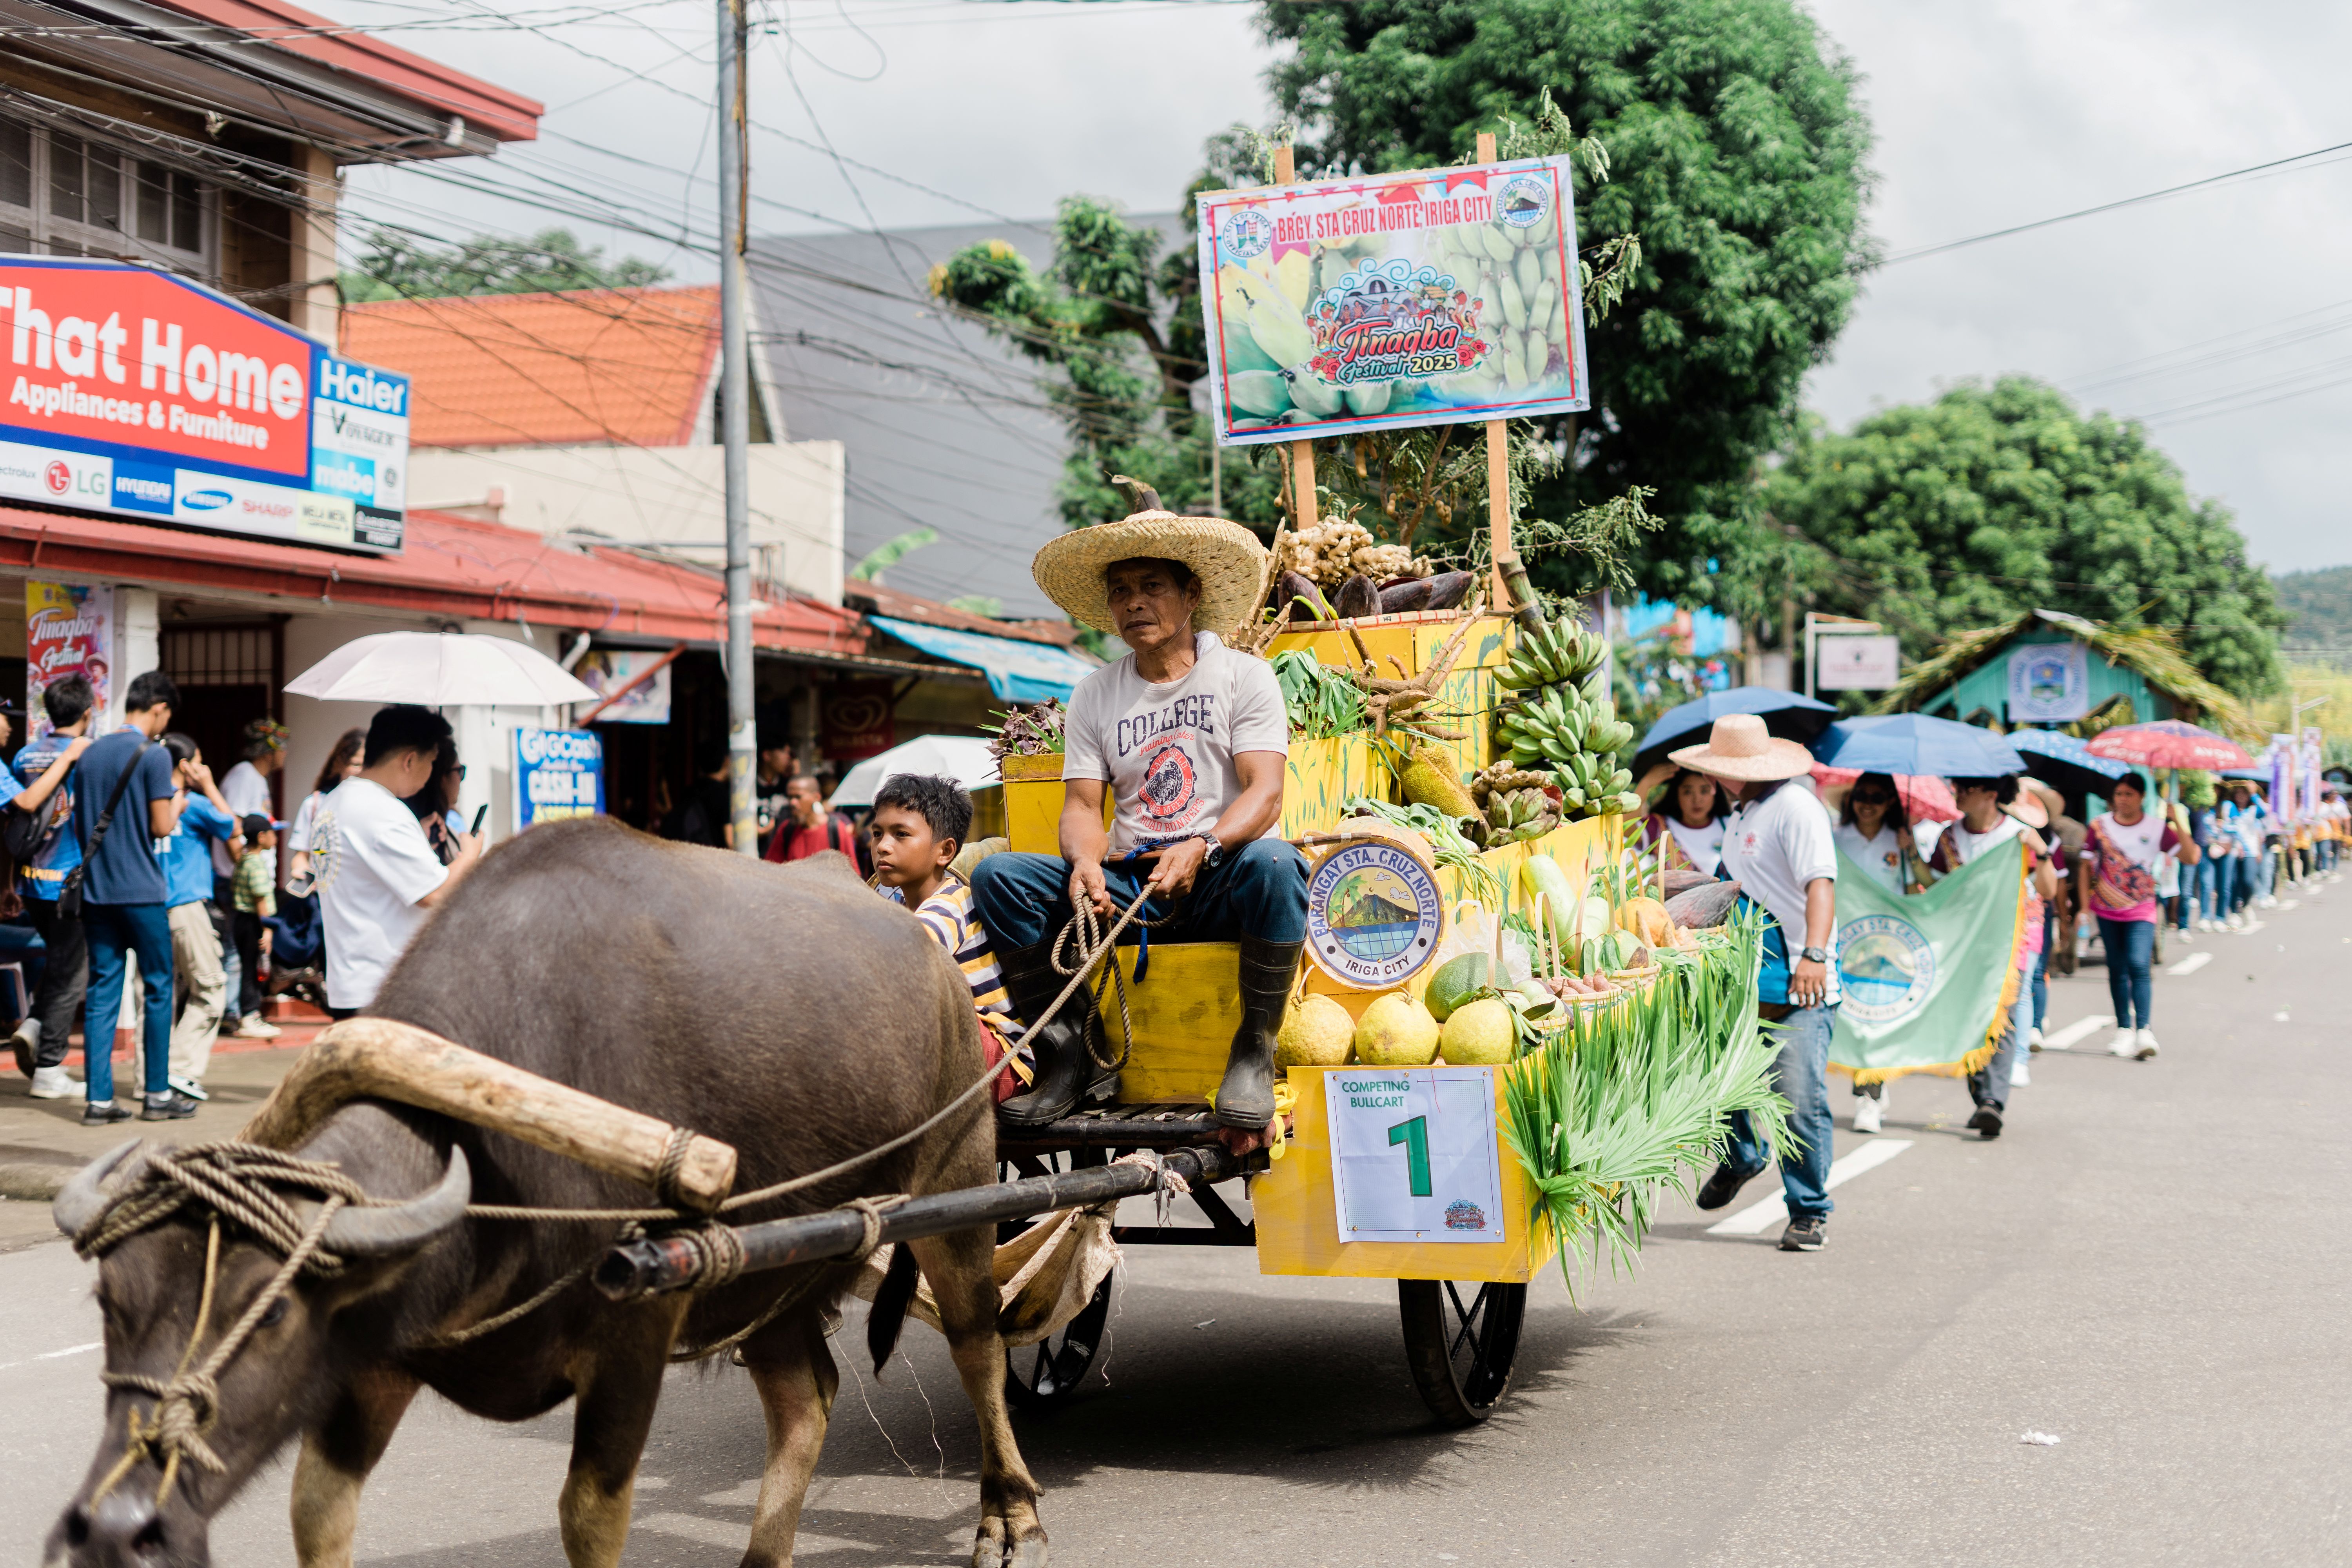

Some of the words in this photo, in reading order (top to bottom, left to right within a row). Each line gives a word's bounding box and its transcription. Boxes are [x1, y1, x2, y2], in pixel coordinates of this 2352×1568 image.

[1278, 215, 1313, 242] BRGY.
[1317, 212, 1339, 238] STA
[1343, 208, 1376, 235] CRUZ
[1425, 199, 1461, 227] IRIGA
[1464, 196, 1491, 222] CITY
[1227, 240, 1255, 256] OFFICIAL
[1257, 238, 1269, 251] SEAL
[1337, 318, 1458, 363] Tinagba
[140, 318, 304, 420] Home
[1339, 357, 1406, 383] Festival
[1411, 354, 1457, 373] 2025
[320, 359, 405, 414] Haier
[9, 376, 144, 426] Appliances
[147, 401, 165, 429] &
[169, 405, 269, 450] Furniture
[78, 470, 105, 495] LG
[116, 476, 172, 499] HYUNDAI
[315, 461, 374, 496] mabe
[185, 492, 229, 507] SAMSUNG
[242, 499, 293, 517] SHARP
[29, 606, 95, 646] Tinagba
[1117, 694, 1214, 757] COLLEGE
[1139, 734, 1173, 757] Training
[1163, 778, 1192, 814] MEETING
[1140, 815, 1162, 832] ROAD
[1165, 798, 1205, 833] RUNNERS
[1160, 828, 1196, 843] School
[1310, 859, 1344, 938] BARANGAY
[1343, 849, 1374, 868] STA.
[1379, 850, 1418, 880] CRUZ
[1412, 876, 1437, 929] NORTE
[1896, 925, 1925, 951] CRUZ
[1345, 959, 1380, 976] IRIGA
[1384, 955, 1410, 976] CITY
[1341, 1080, 1410, 1093] COMPETING
[1350, 1096, 1404, 1108] BULLCART
[1388, 1115, 1433, 1197] 1
[1452, 1213, 1479, 1225] Tinagba
